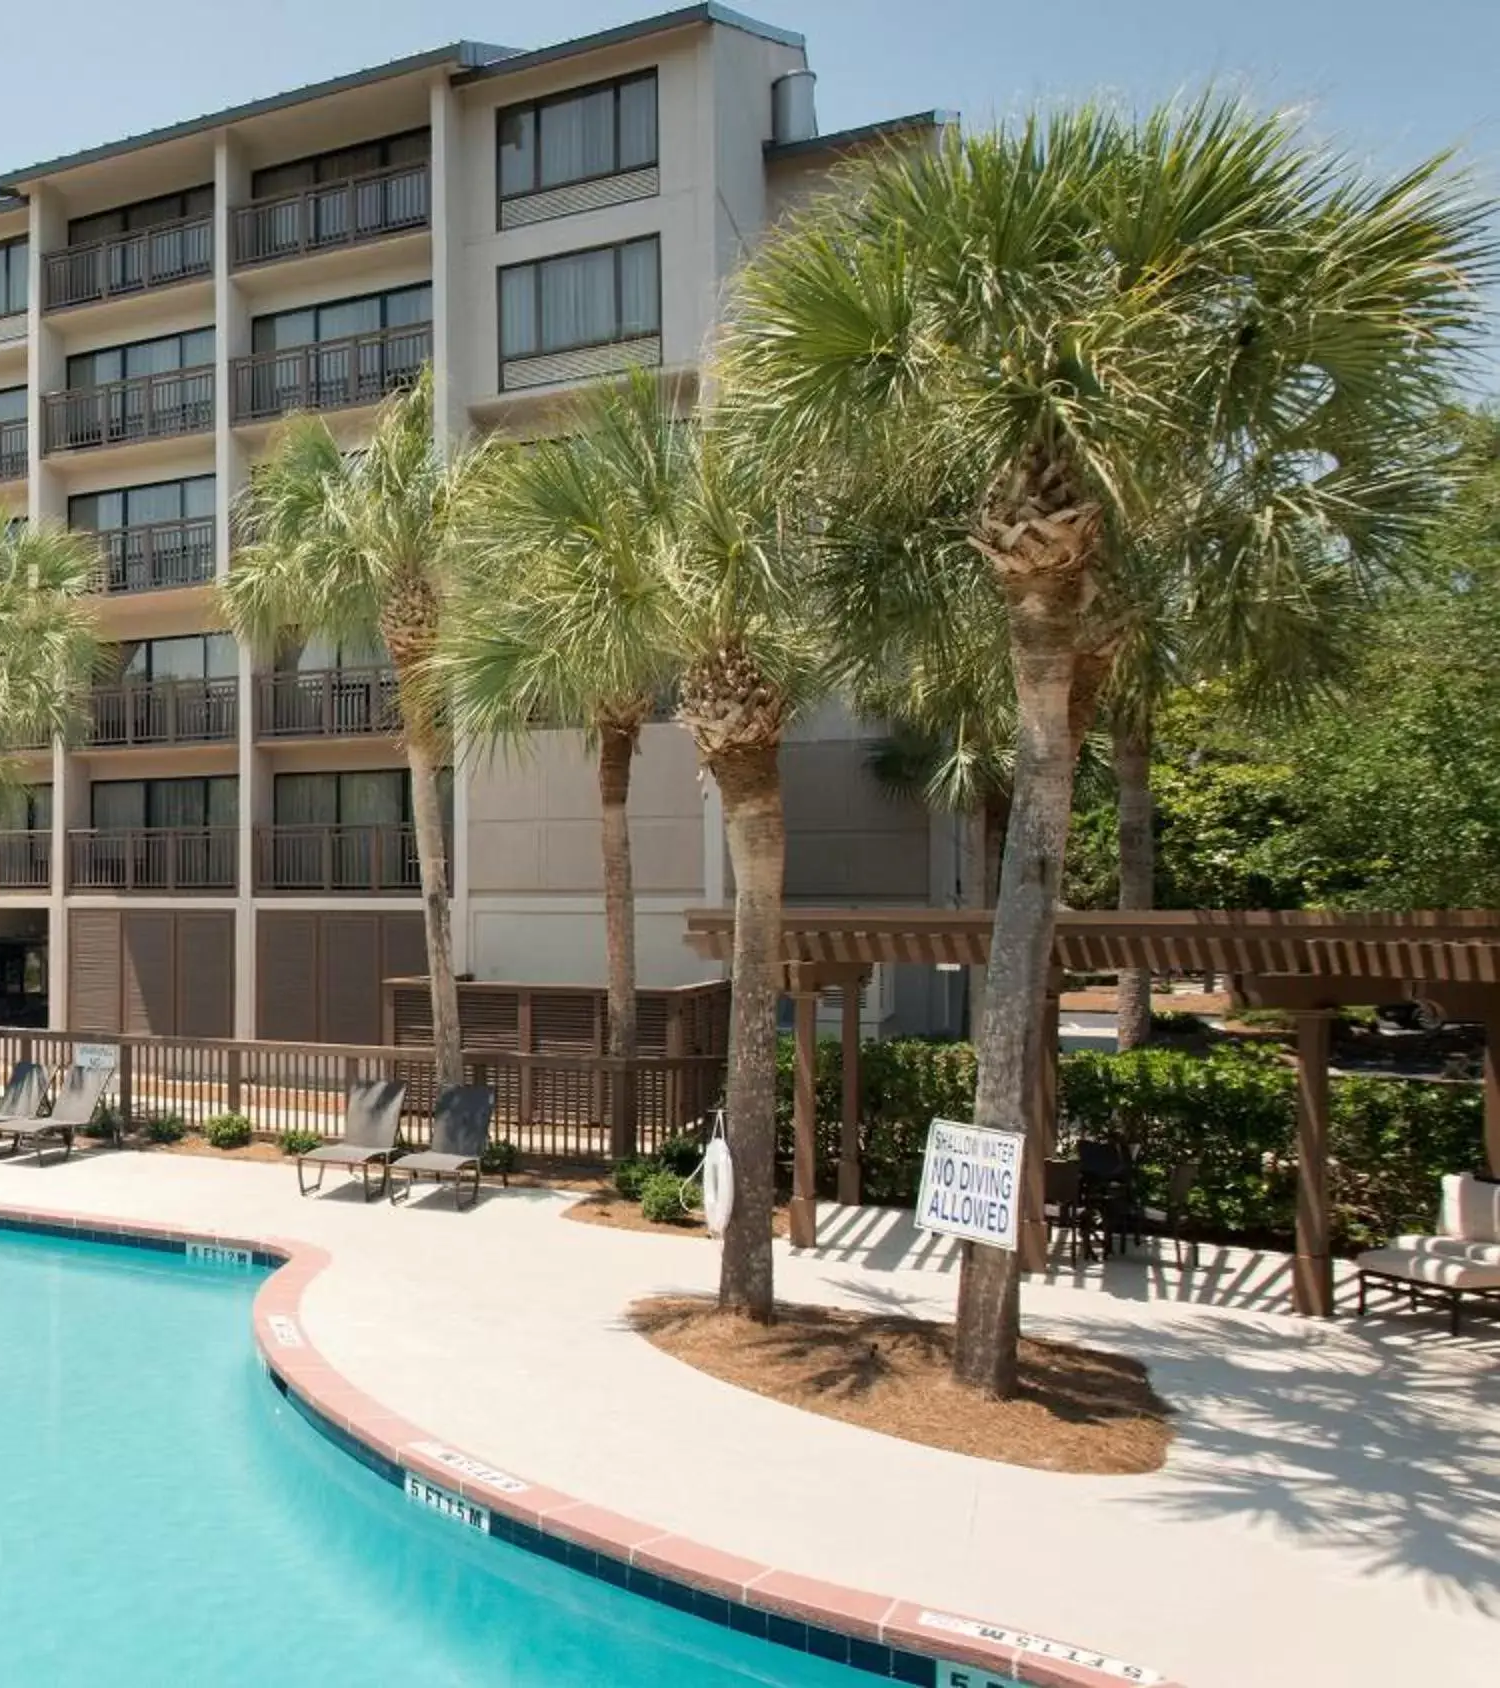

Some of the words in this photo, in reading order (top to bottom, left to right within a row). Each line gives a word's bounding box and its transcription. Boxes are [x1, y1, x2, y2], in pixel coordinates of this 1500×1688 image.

[931, 1157, 955, 1187] NO
[959, 1161, 1013, 1200] DIVING
[927, 1189, 1010, 1233] ALLOWED
